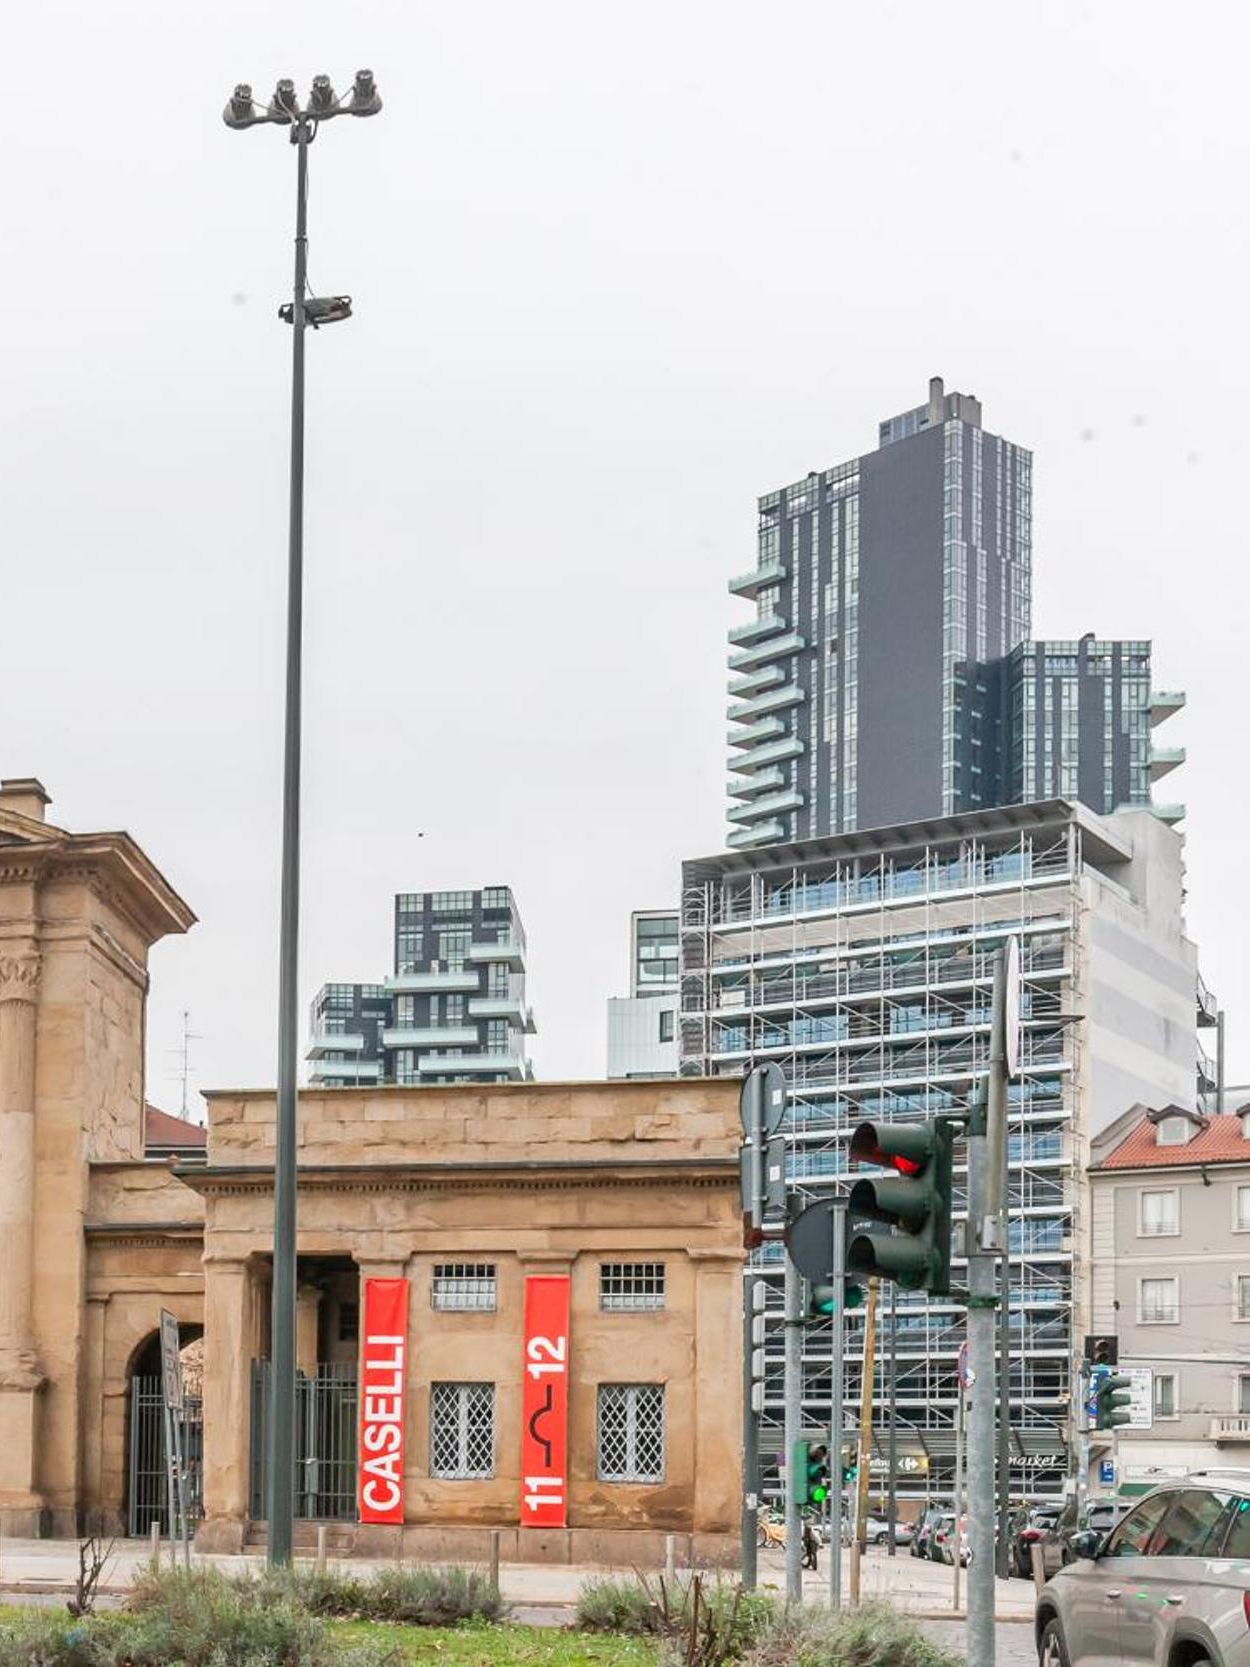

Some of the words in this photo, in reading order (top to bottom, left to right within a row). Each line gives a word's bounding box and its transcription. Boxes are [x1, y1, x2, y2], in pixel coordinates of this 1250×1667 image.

[527, 1336, 566, 1379] 12
[362, 1335, 404, 1511] CASELLI
[524, 1476, 563, 1511] 11
